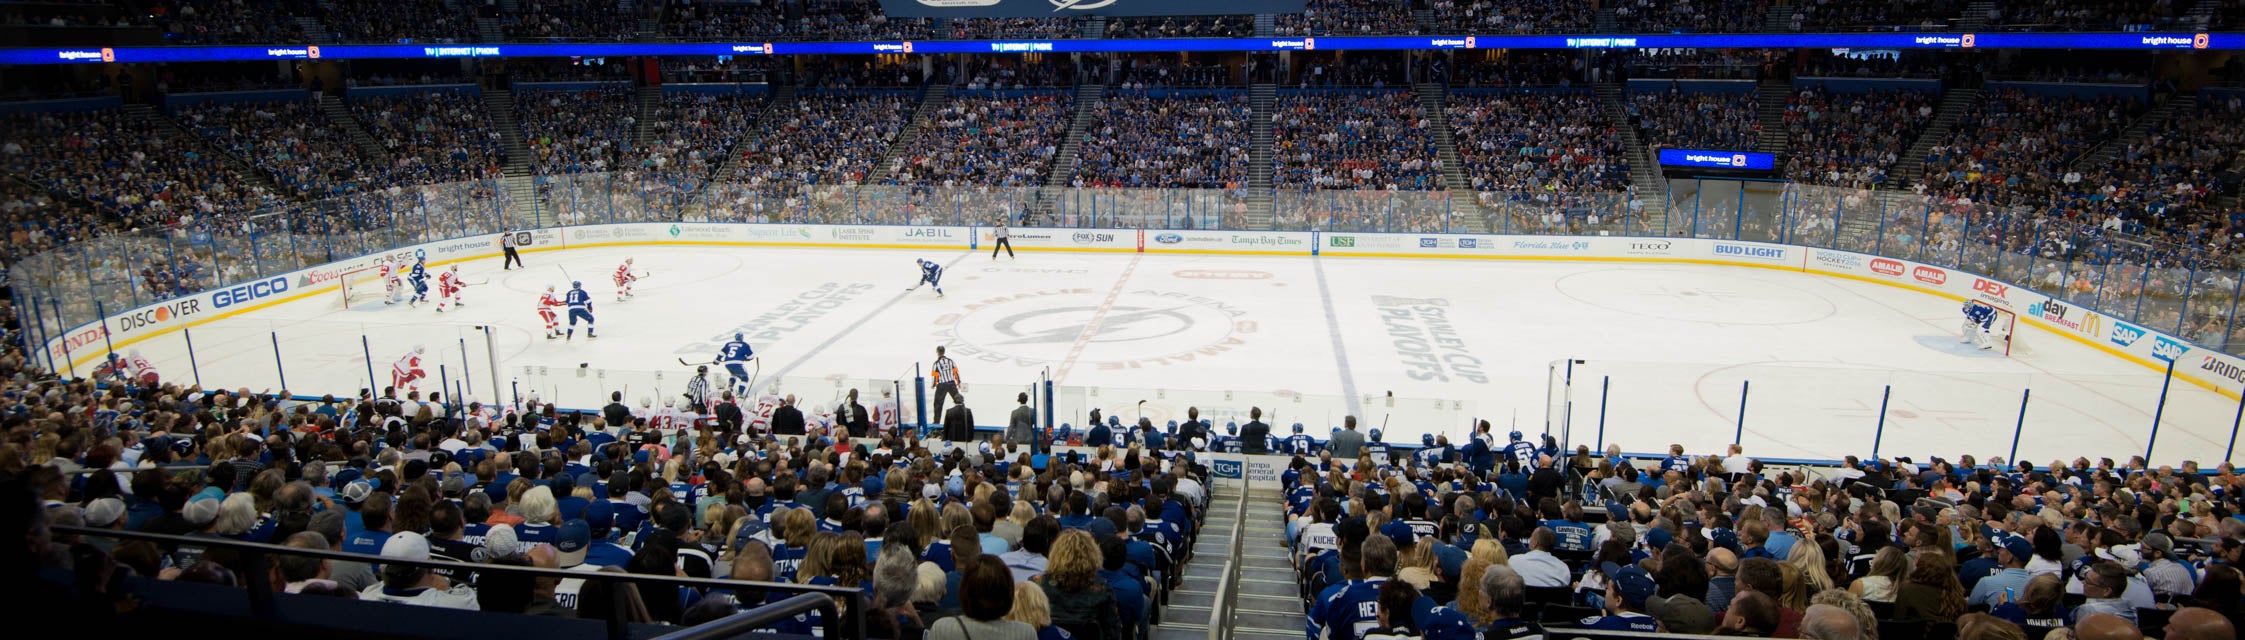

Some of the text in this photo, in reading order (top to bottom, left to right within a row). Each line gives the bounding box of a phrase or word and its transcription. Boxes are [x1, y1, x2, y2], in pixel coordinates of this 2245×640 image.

[1567, 38, 1636, 47] TV INTERNET PHONE
[1915, 37, 1937, 45] bright
[2142, 36, 2167, 45] bright
[425, 47, 500, 55] TV INTERNET PHONE
[991, 42, 1053, 51] TV INTERNET PHONE
[1686, 154, 1708, 163] bright
[904, 228, 953, 237] JABIL
[1076, 233, 1114, 242] FOX SUN
[1232, 235, 1259, 245] Tampa
[1261, 235, 1276, 245] Bay
[1277, 236, 1302, 245] Times
[1331, 236, 1354, 247] USF
[1513, 241, 1569, 250] Florida Blue
[438, 240, 491, 253] bright house
[1715, 245, 1784, 258] BUD LIGHT
[1816, 251, 1842, 259] WORLD
[1816, 256, 1861, 267] HOCKEY 2016
[1872, 261, 1903, 272] AMALIE
[306, 268, 339, 286] Coors
[1915, 268, 1945, 280] AMALIE
[212, 276, 289, 309] GEICO
[1972, 277, 2010, 299] DEX
[1980, 292, 2010, 307] imaging
[2028, 297, 2068, 319] all day
[120, 299, 201, 332] DISCOVER
[2044, 313, 2080, 330] BREAKFAST
[2112, 324, 2139, 344] SAP
[52, 324, 113, 360] HONDA
[728, 346, 738, 358] 5
[2153, 338, 2184, 359] SAP
[883, 408, 898, 426] 21
[1115, 433, 1125, 446] 9
[1215, 463, 1241, 474] TGH
[1247, 461, 1271, 469] ampa
[1247, 467, 1275, 475] eneral
[1313, 535, 1336, 545] KUCHE
[1630, 622, 1654, 630] Reebok
[2026, 617, 2064, 627] JOHNSON
